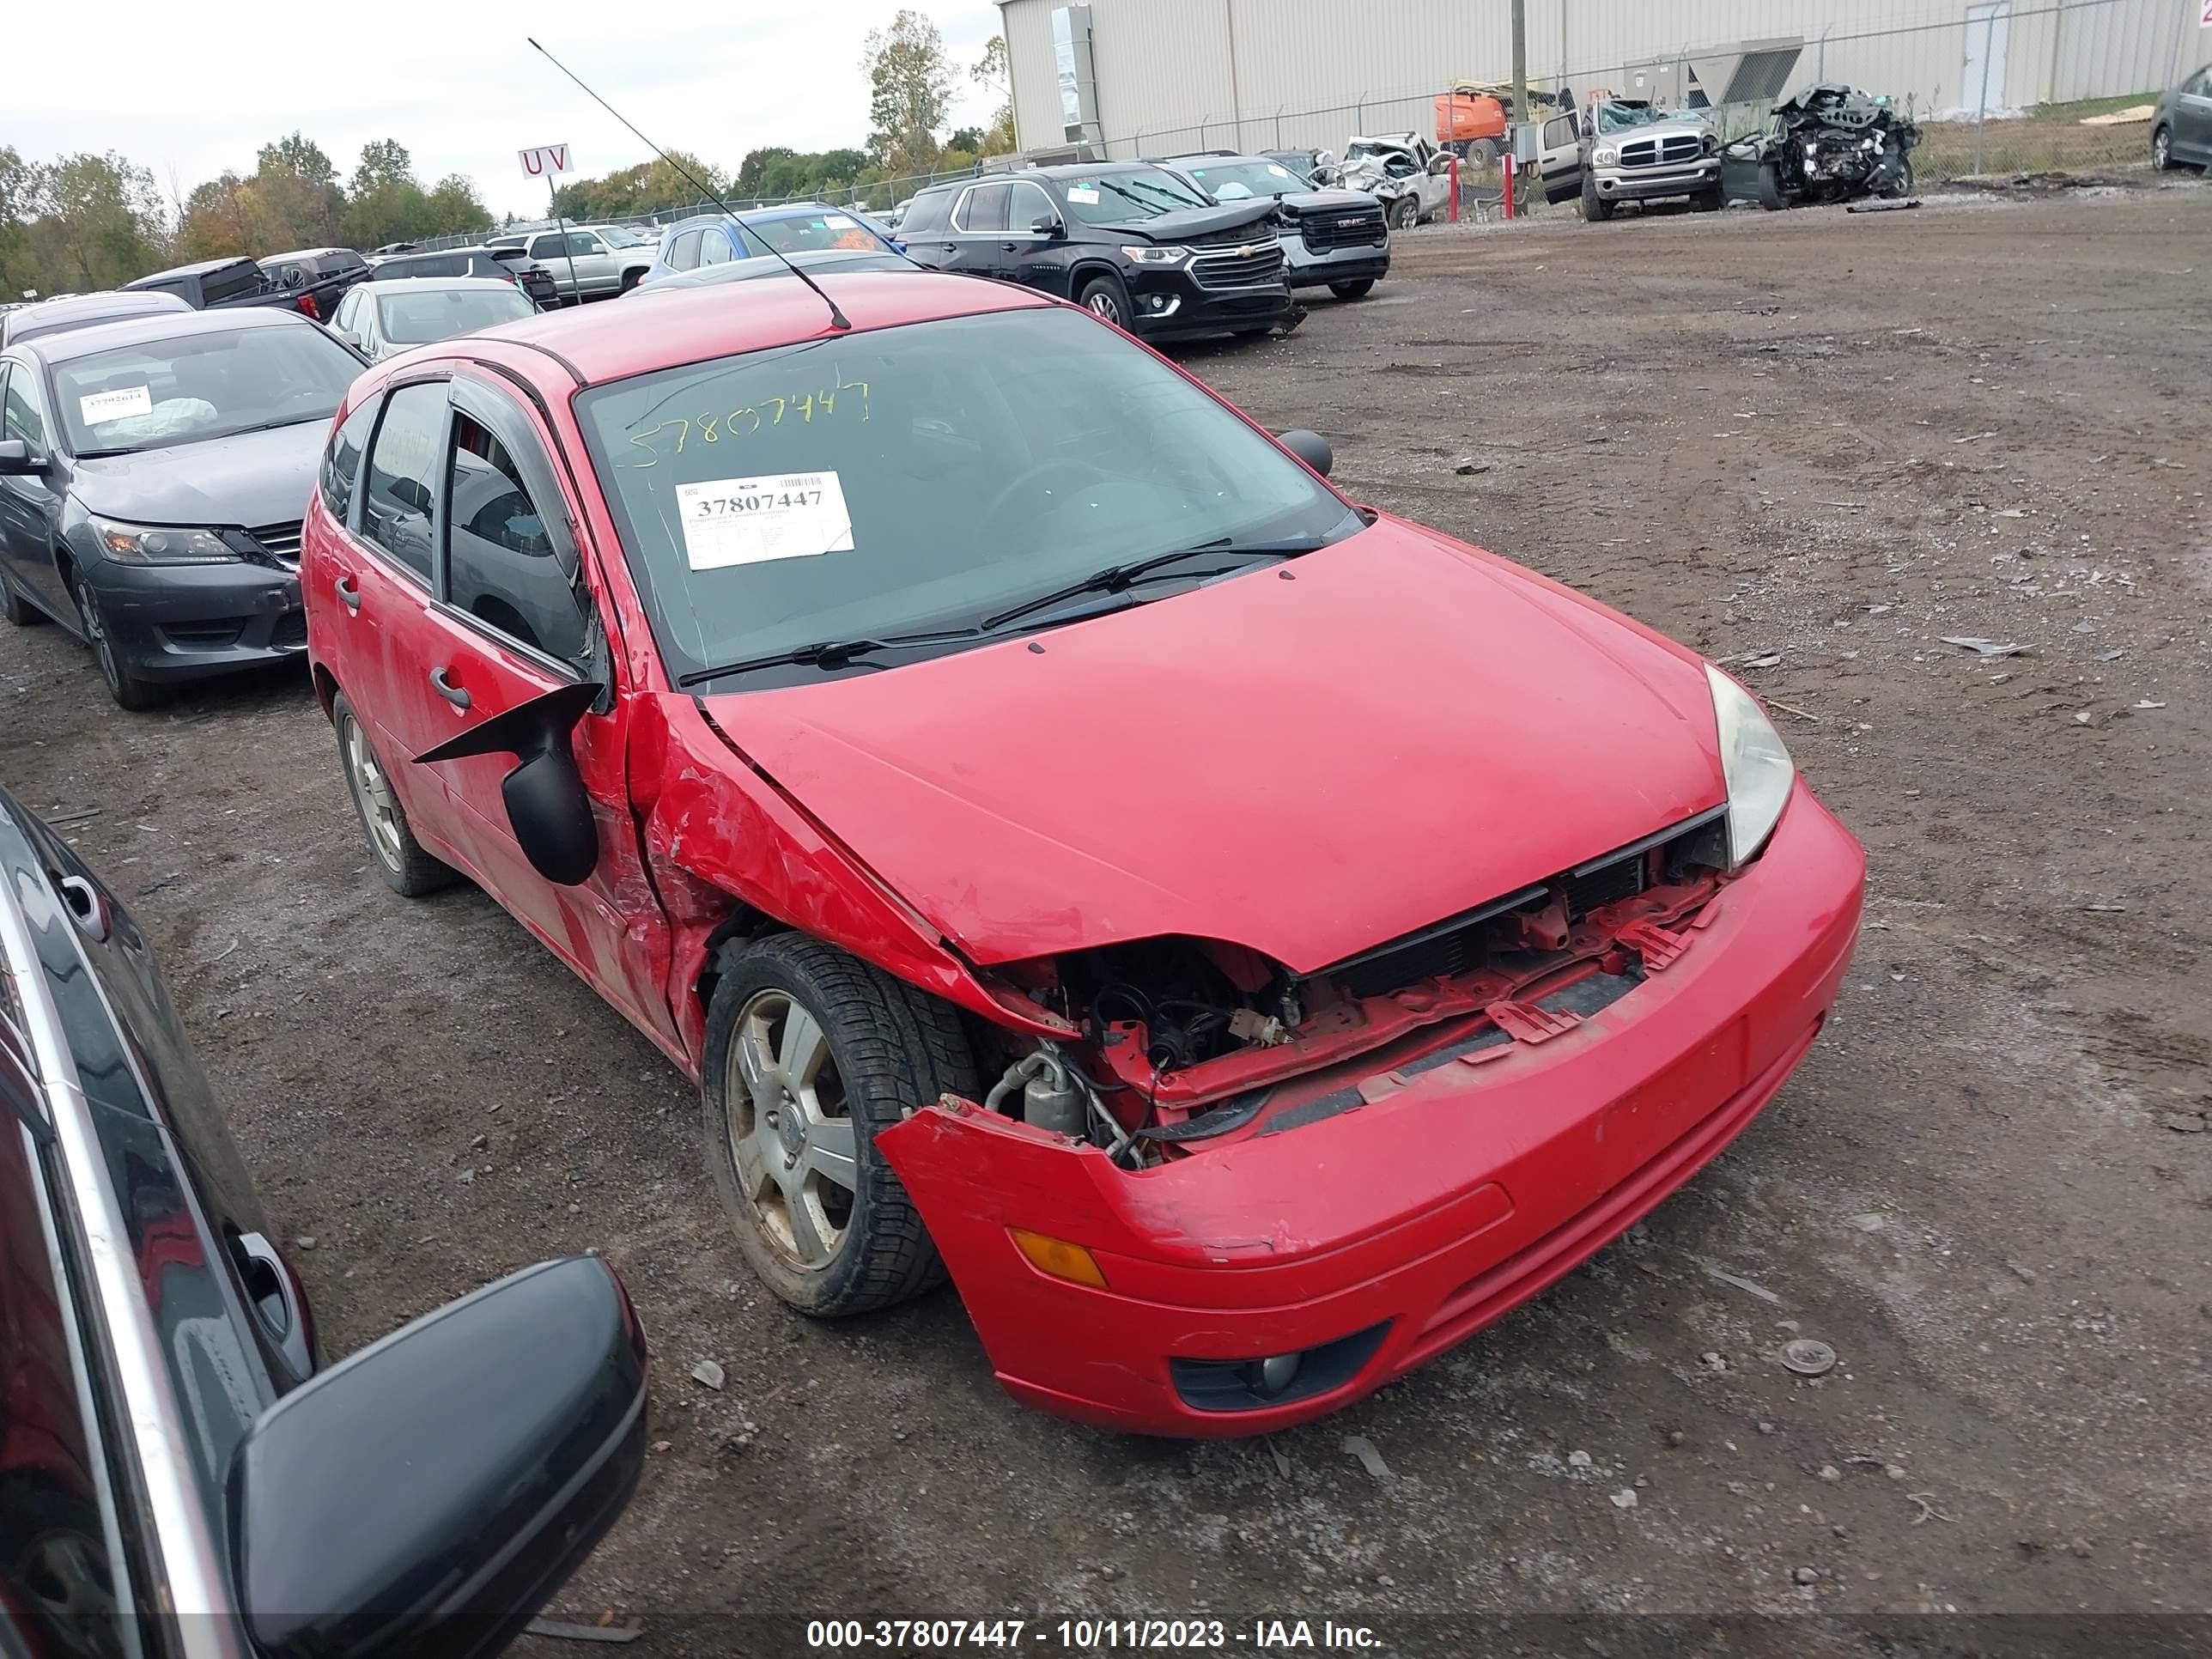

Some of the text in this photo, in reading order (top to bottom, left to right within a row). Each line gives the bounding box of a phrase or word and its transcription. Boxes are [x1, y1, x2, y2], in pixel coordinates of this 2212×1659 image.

[523, 147, 564, 175] UV
[1337, 218, 1366, 228] GMC
[697, 490, 822, 517] 37807447
